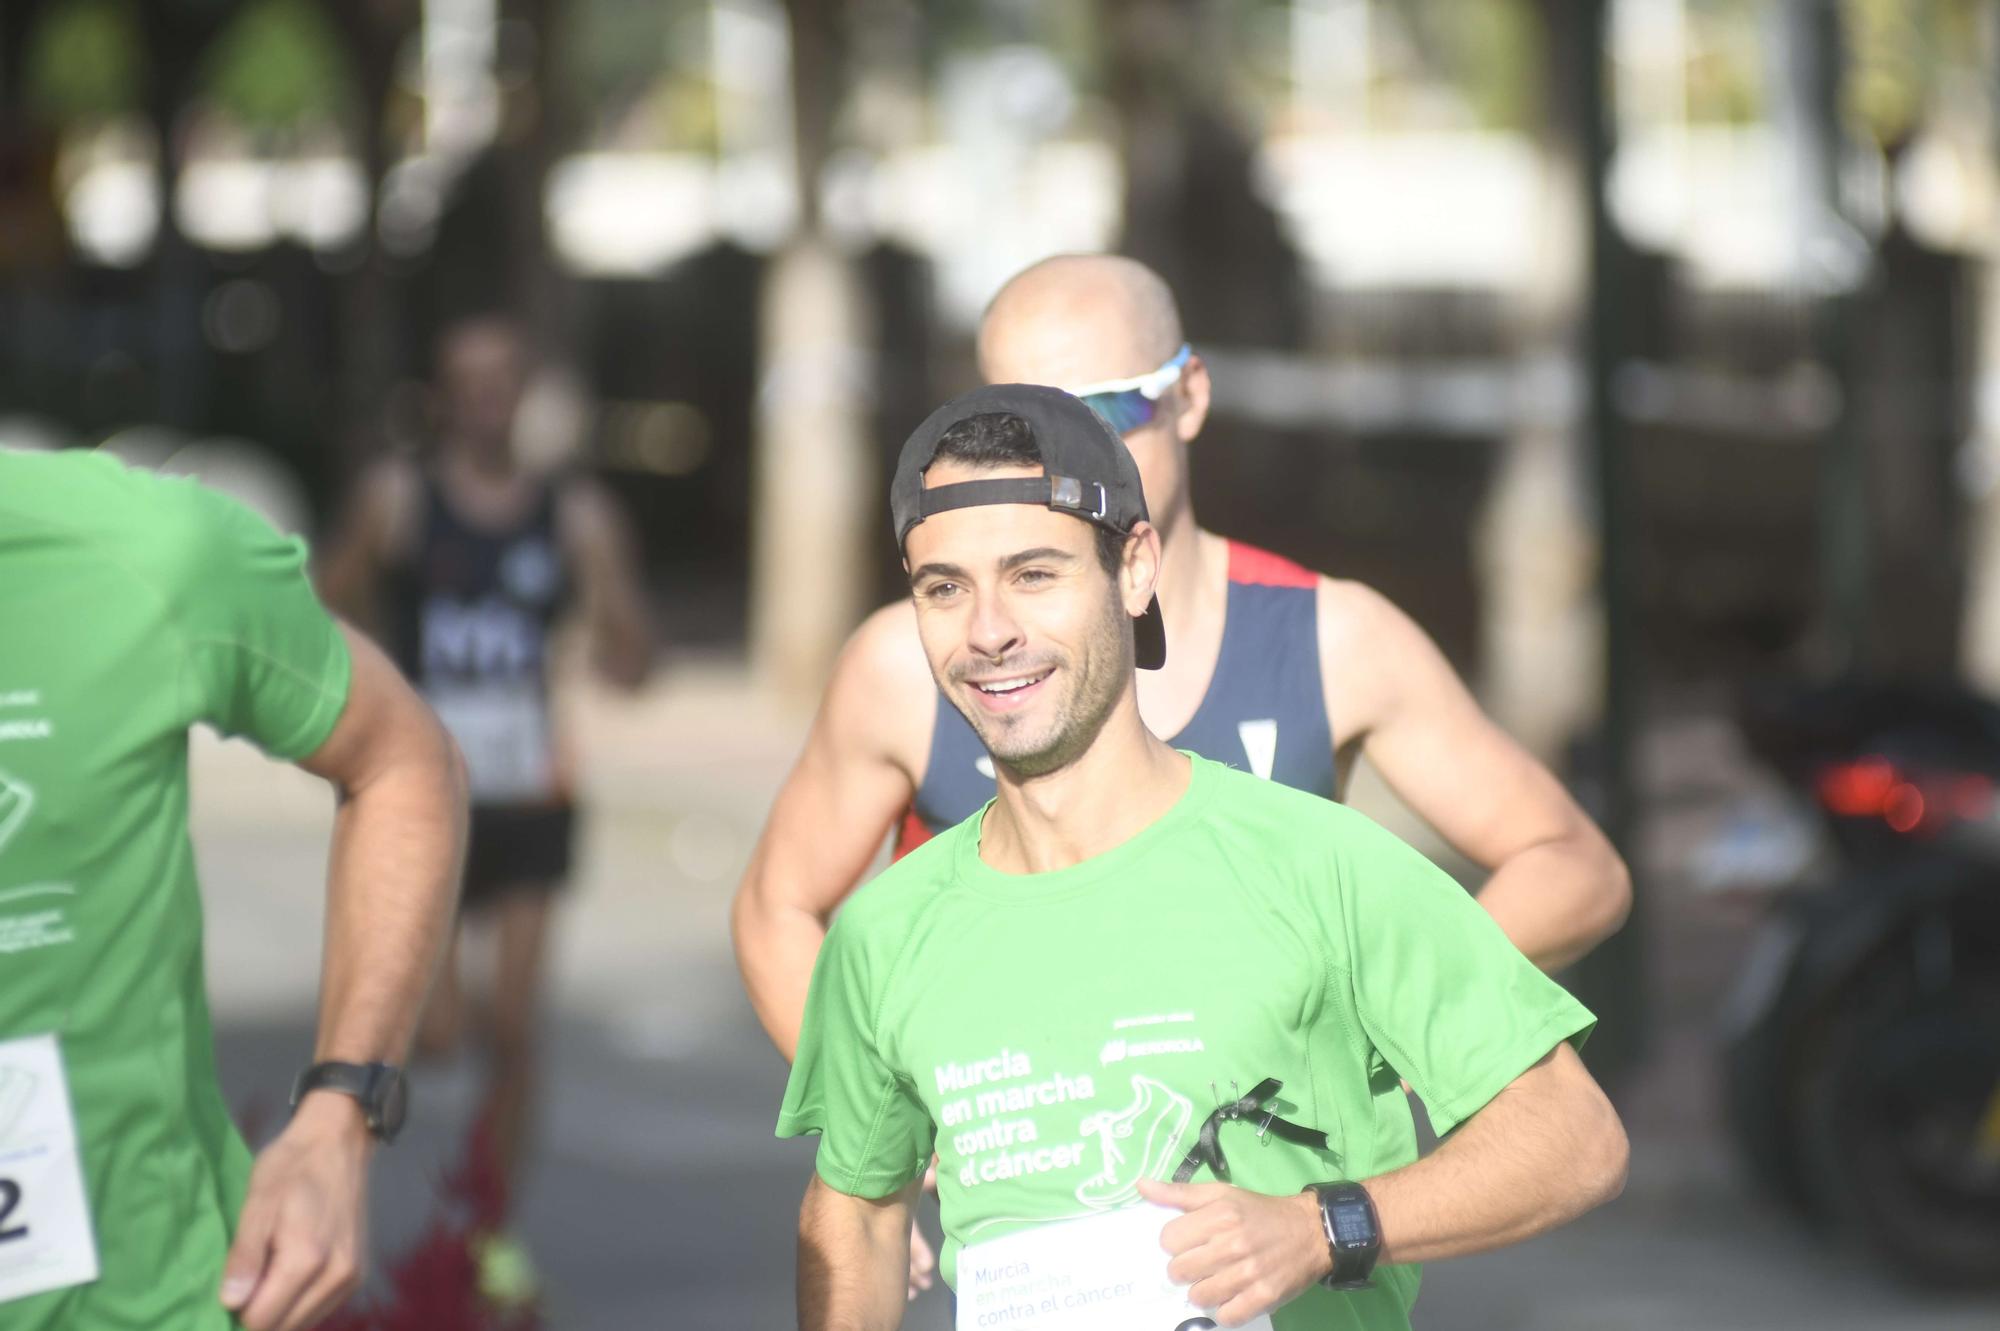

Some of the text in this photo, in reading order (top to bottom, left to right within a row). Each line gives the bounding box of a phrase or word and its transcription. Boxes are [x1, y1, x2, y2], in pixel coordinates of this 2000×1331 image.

[935, 1049, 1031, 1094] Murcia
[941, 1071, 1095, 1127] en marcha
[953, 1118, 1037, 1156] contra
[959, 1142, 1086, 1187] el cáncer
[975, 1260, 1031, 1286] Murcia
[976, 1273, 1073, 1307] en marcha
[977, 1302, 1037, 1329] contra
[1041, 1296, 1058, 1314] el
